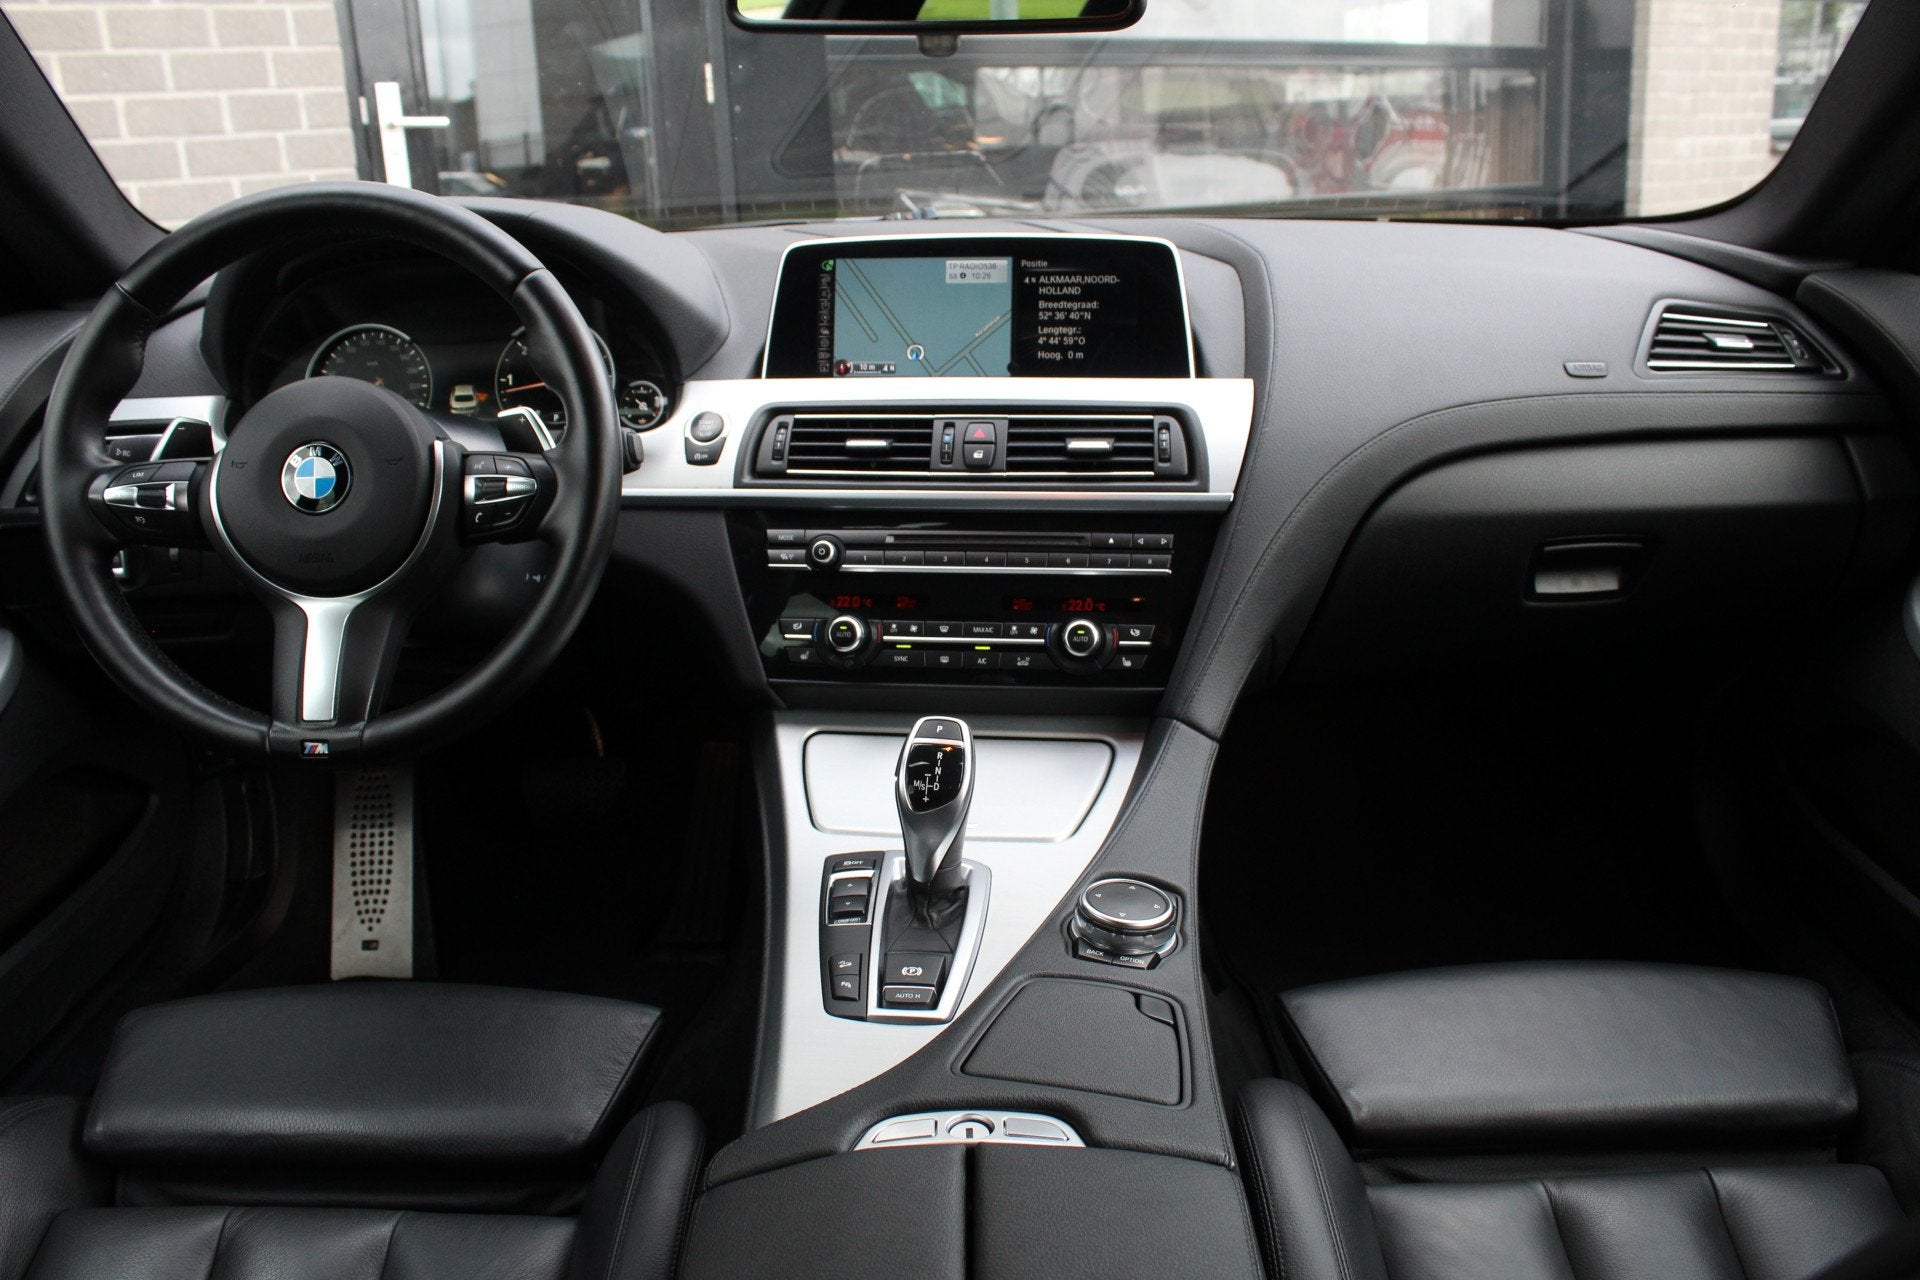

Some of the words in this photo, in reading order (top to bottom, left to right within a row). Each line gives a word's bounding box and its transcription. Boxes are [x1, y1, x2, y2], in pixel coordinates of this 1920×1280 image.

[1021, 260, 1048, 268] Positie
[1039, 287, 1081, 295] HOLLAND
[1039, 301, 1100, 311] Breedtegraad:
[1038, 326, 1081, 335] Lengtegr.:
[521, 346, 528, 355] 2
[1038, 351, 1064, 361] Hoog.
[1067, 351, 1074, 359] 0
[506, 374, 513, 385] 1
[289, 446, 344, 468] BMW
[1073, 635, 1088, 643] AUTO
[936, 725, 943, 733] P
[936, 752, 943, 760] R
[935, 766, 942, 775] N
[913, 780, 926, 791] M/S
[933, 782, 940, 791] D
[1086, 949, 1104, 957] BACK
[1120, 956, 1145, 965] OPTION
